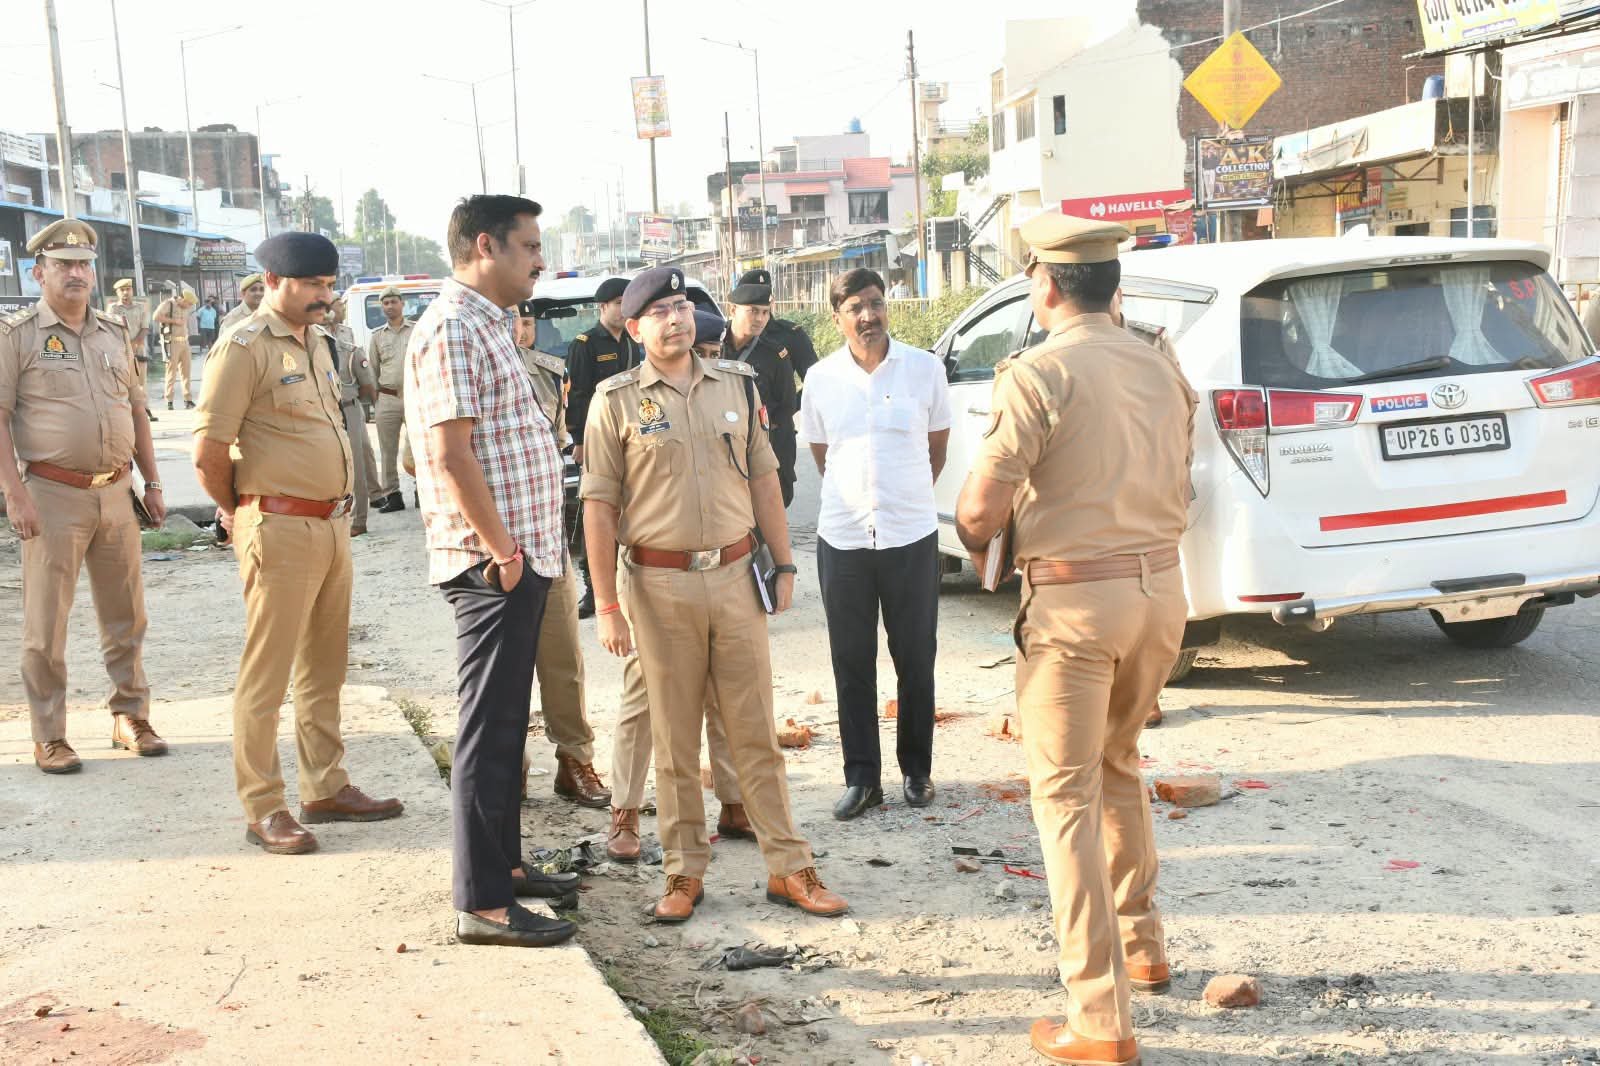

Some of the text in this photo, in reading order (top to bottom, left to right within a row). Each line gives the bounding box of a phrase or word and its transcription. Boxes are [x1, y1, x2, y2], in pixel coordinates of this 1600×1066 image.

[1215, 161, 1270, 174] COLLECTION
[1107, 199, 1164, 215] HAVELLS
[1377, 399, 1423, 411] POLICE
[1397, 428, 1440, 450] UP26
[1445, 427, 1455, 446] G
[1460, 422, 1503, 444] 0368
